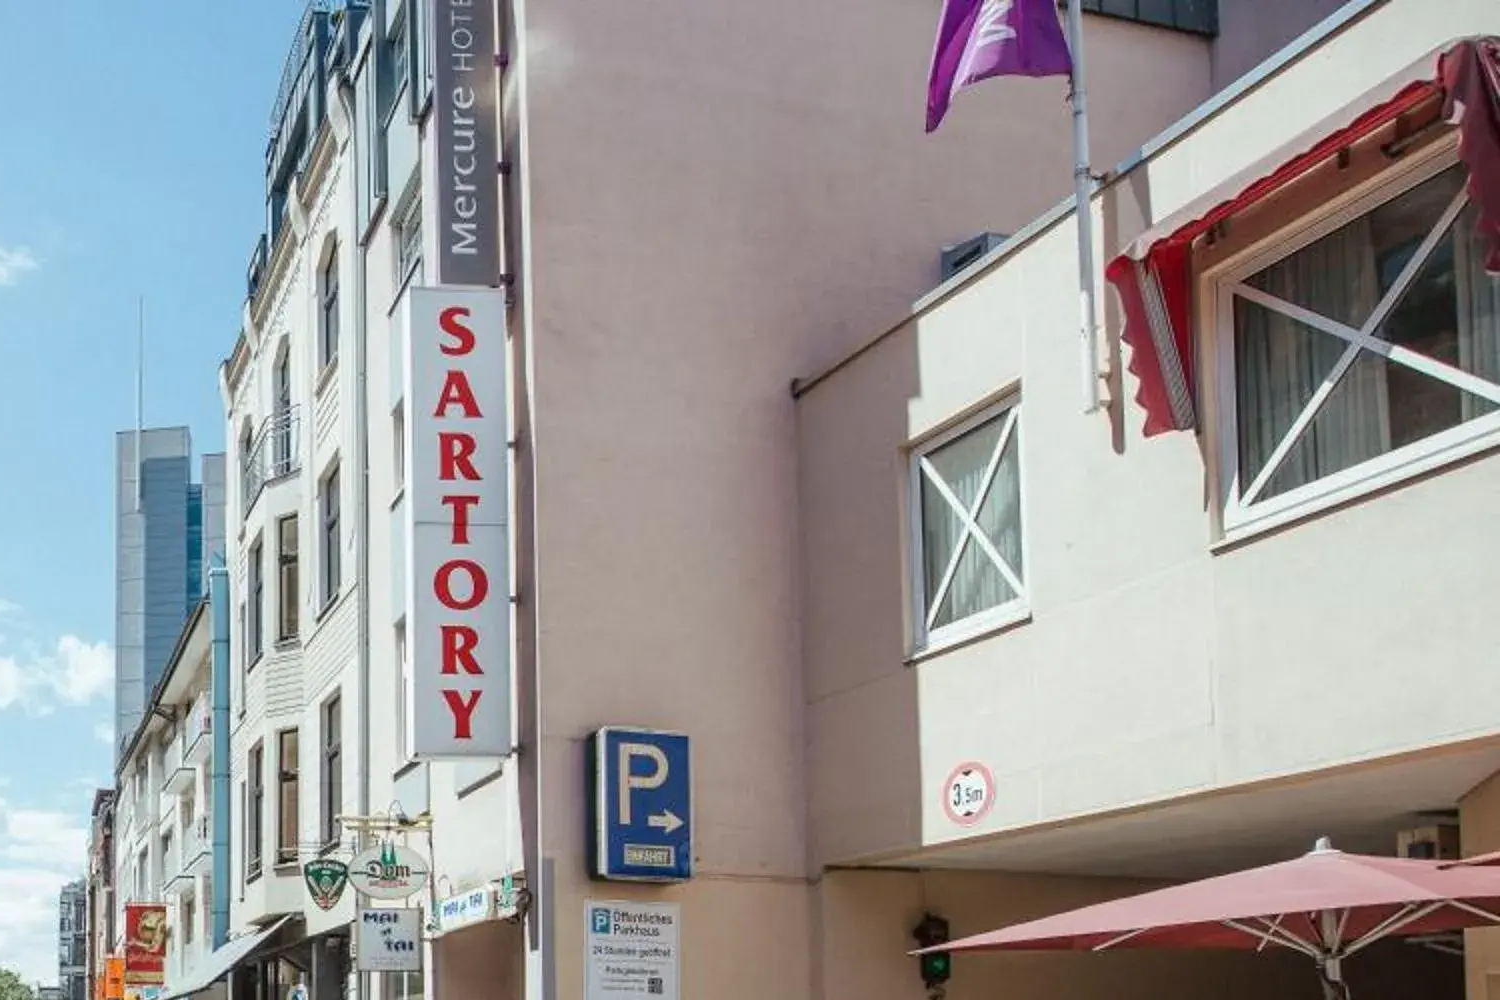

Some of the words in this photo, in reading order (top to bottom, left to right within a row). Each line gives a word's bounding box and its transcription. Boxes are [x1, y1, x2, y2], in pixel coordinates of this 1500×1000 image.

[451, 86, 477, 255] Mercure
[432, 306, 488, 739] SARTORY
[618, 742, 669, 825] P
[366, 860, 411, 880] Dom
[363, 912, 398, 924] MAI
[613, 924, 660, 937] Parkhaus
